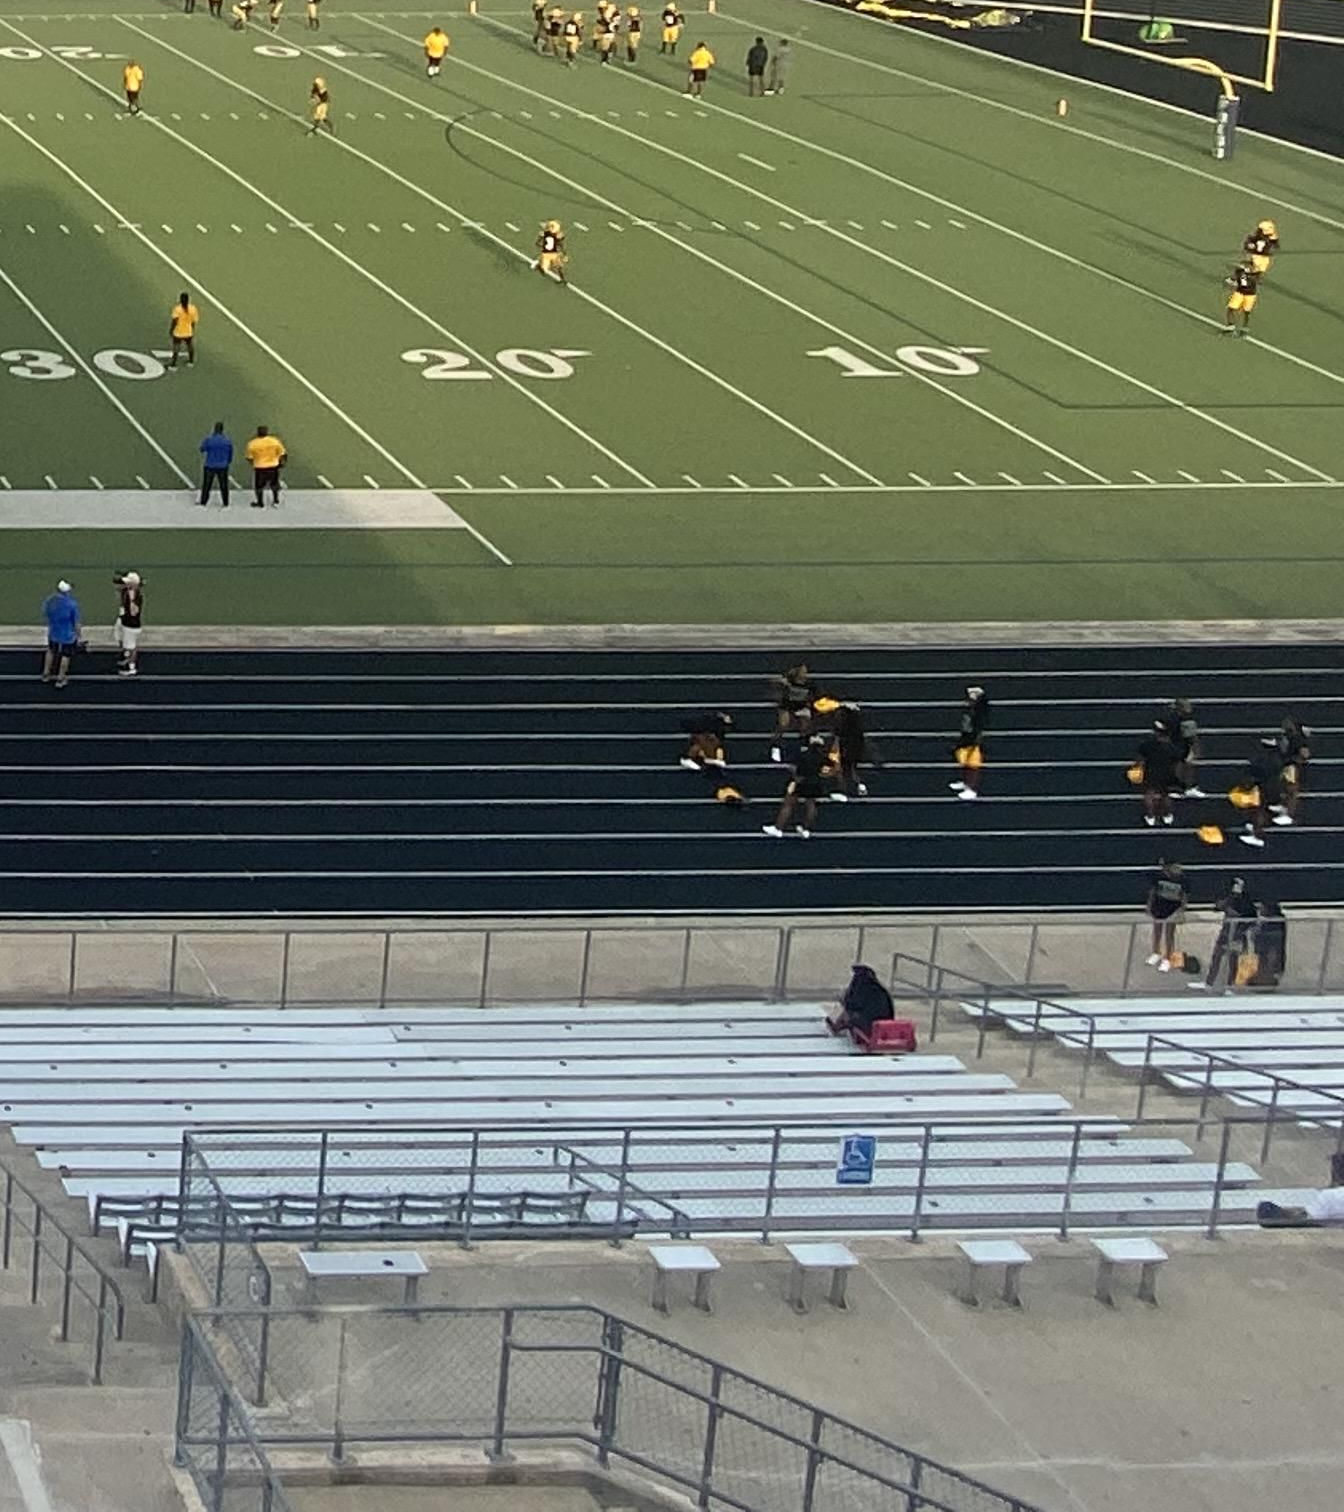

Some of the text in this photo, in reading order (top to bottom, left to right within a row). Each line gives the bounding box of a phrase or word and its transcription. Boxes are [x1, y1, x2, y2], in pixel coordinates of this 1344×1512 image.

[0, 348, 168, 380] 30
[401, 348, 574, 380] 20
[805, 345, 981, 377] 10
